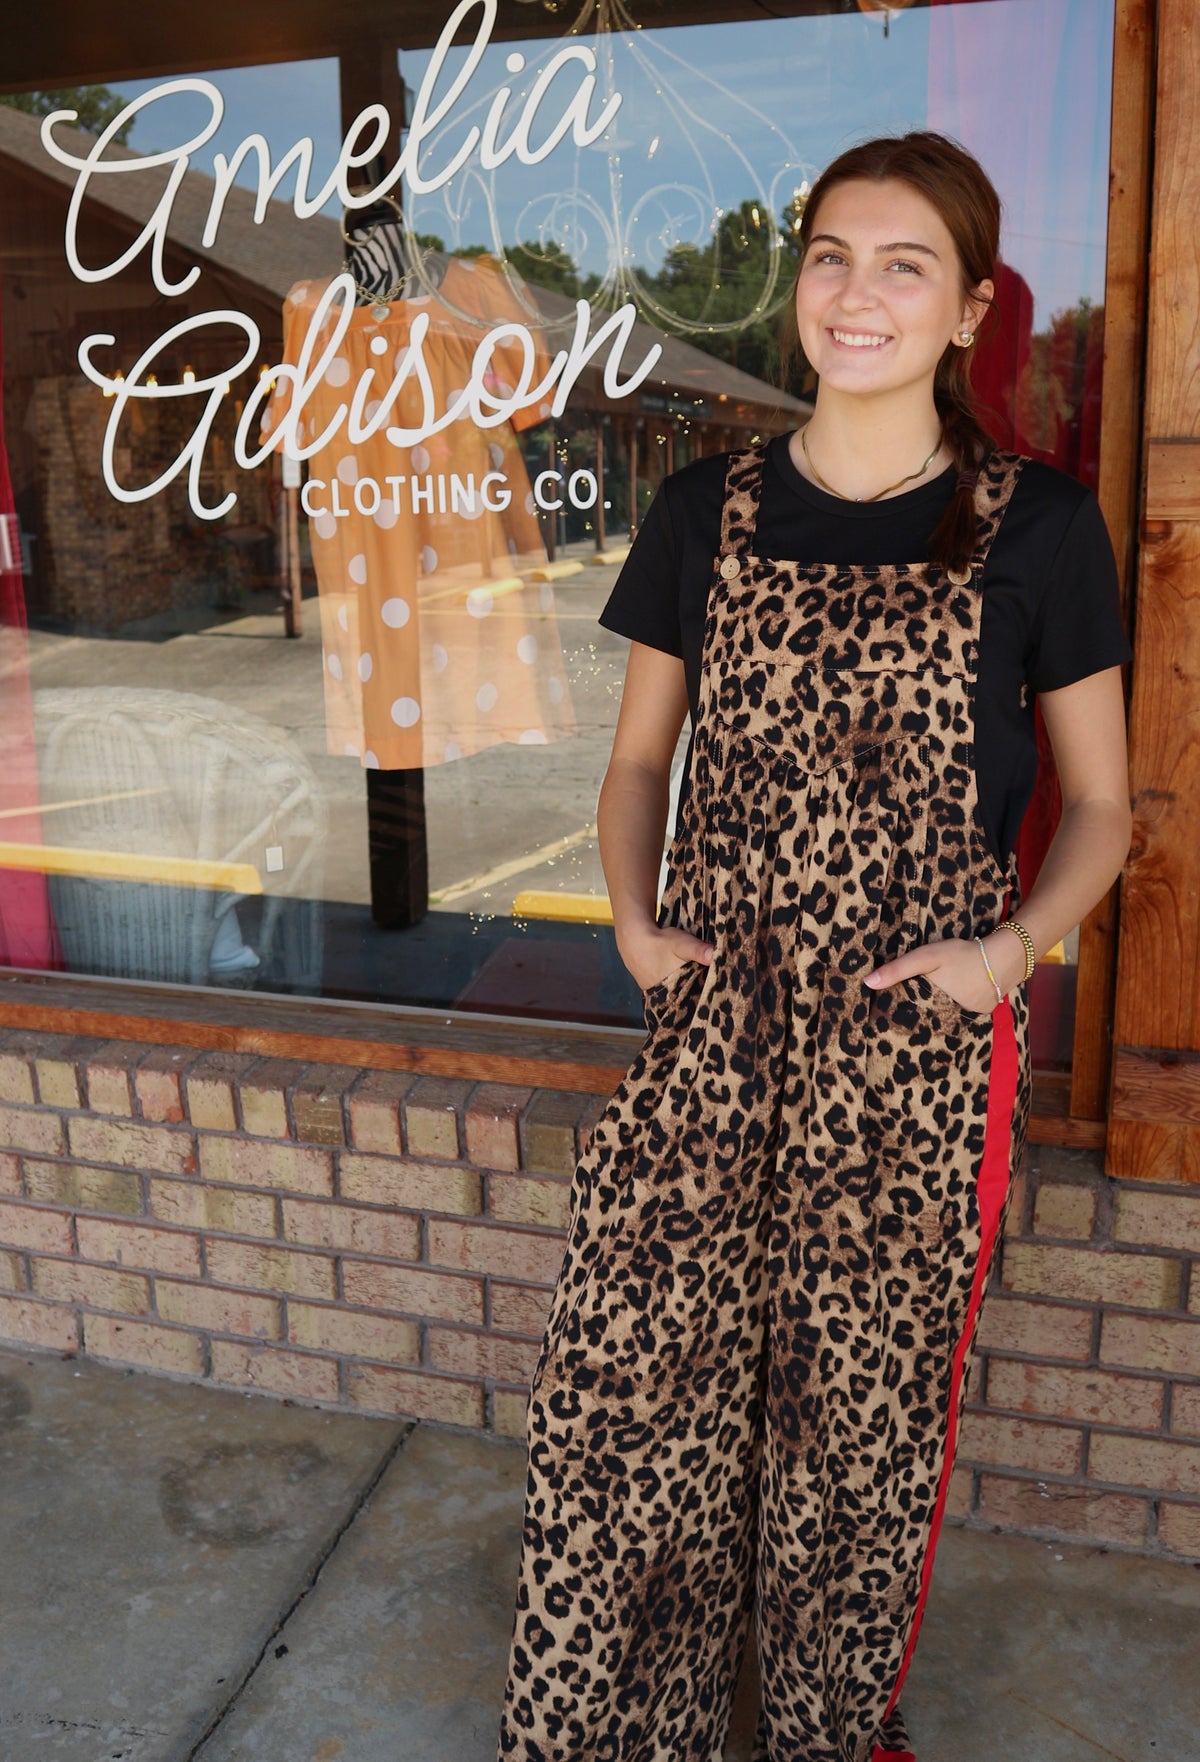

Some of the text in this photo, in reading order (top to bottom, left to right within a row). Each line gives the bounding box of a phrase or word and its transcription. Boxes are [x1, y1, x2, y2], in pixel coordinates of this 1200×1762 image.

[41, 0, 622, 296] Amelia
[78, 273, 662, 519] Adison
[301, 469, 611, 517] CLOTHING CO.
